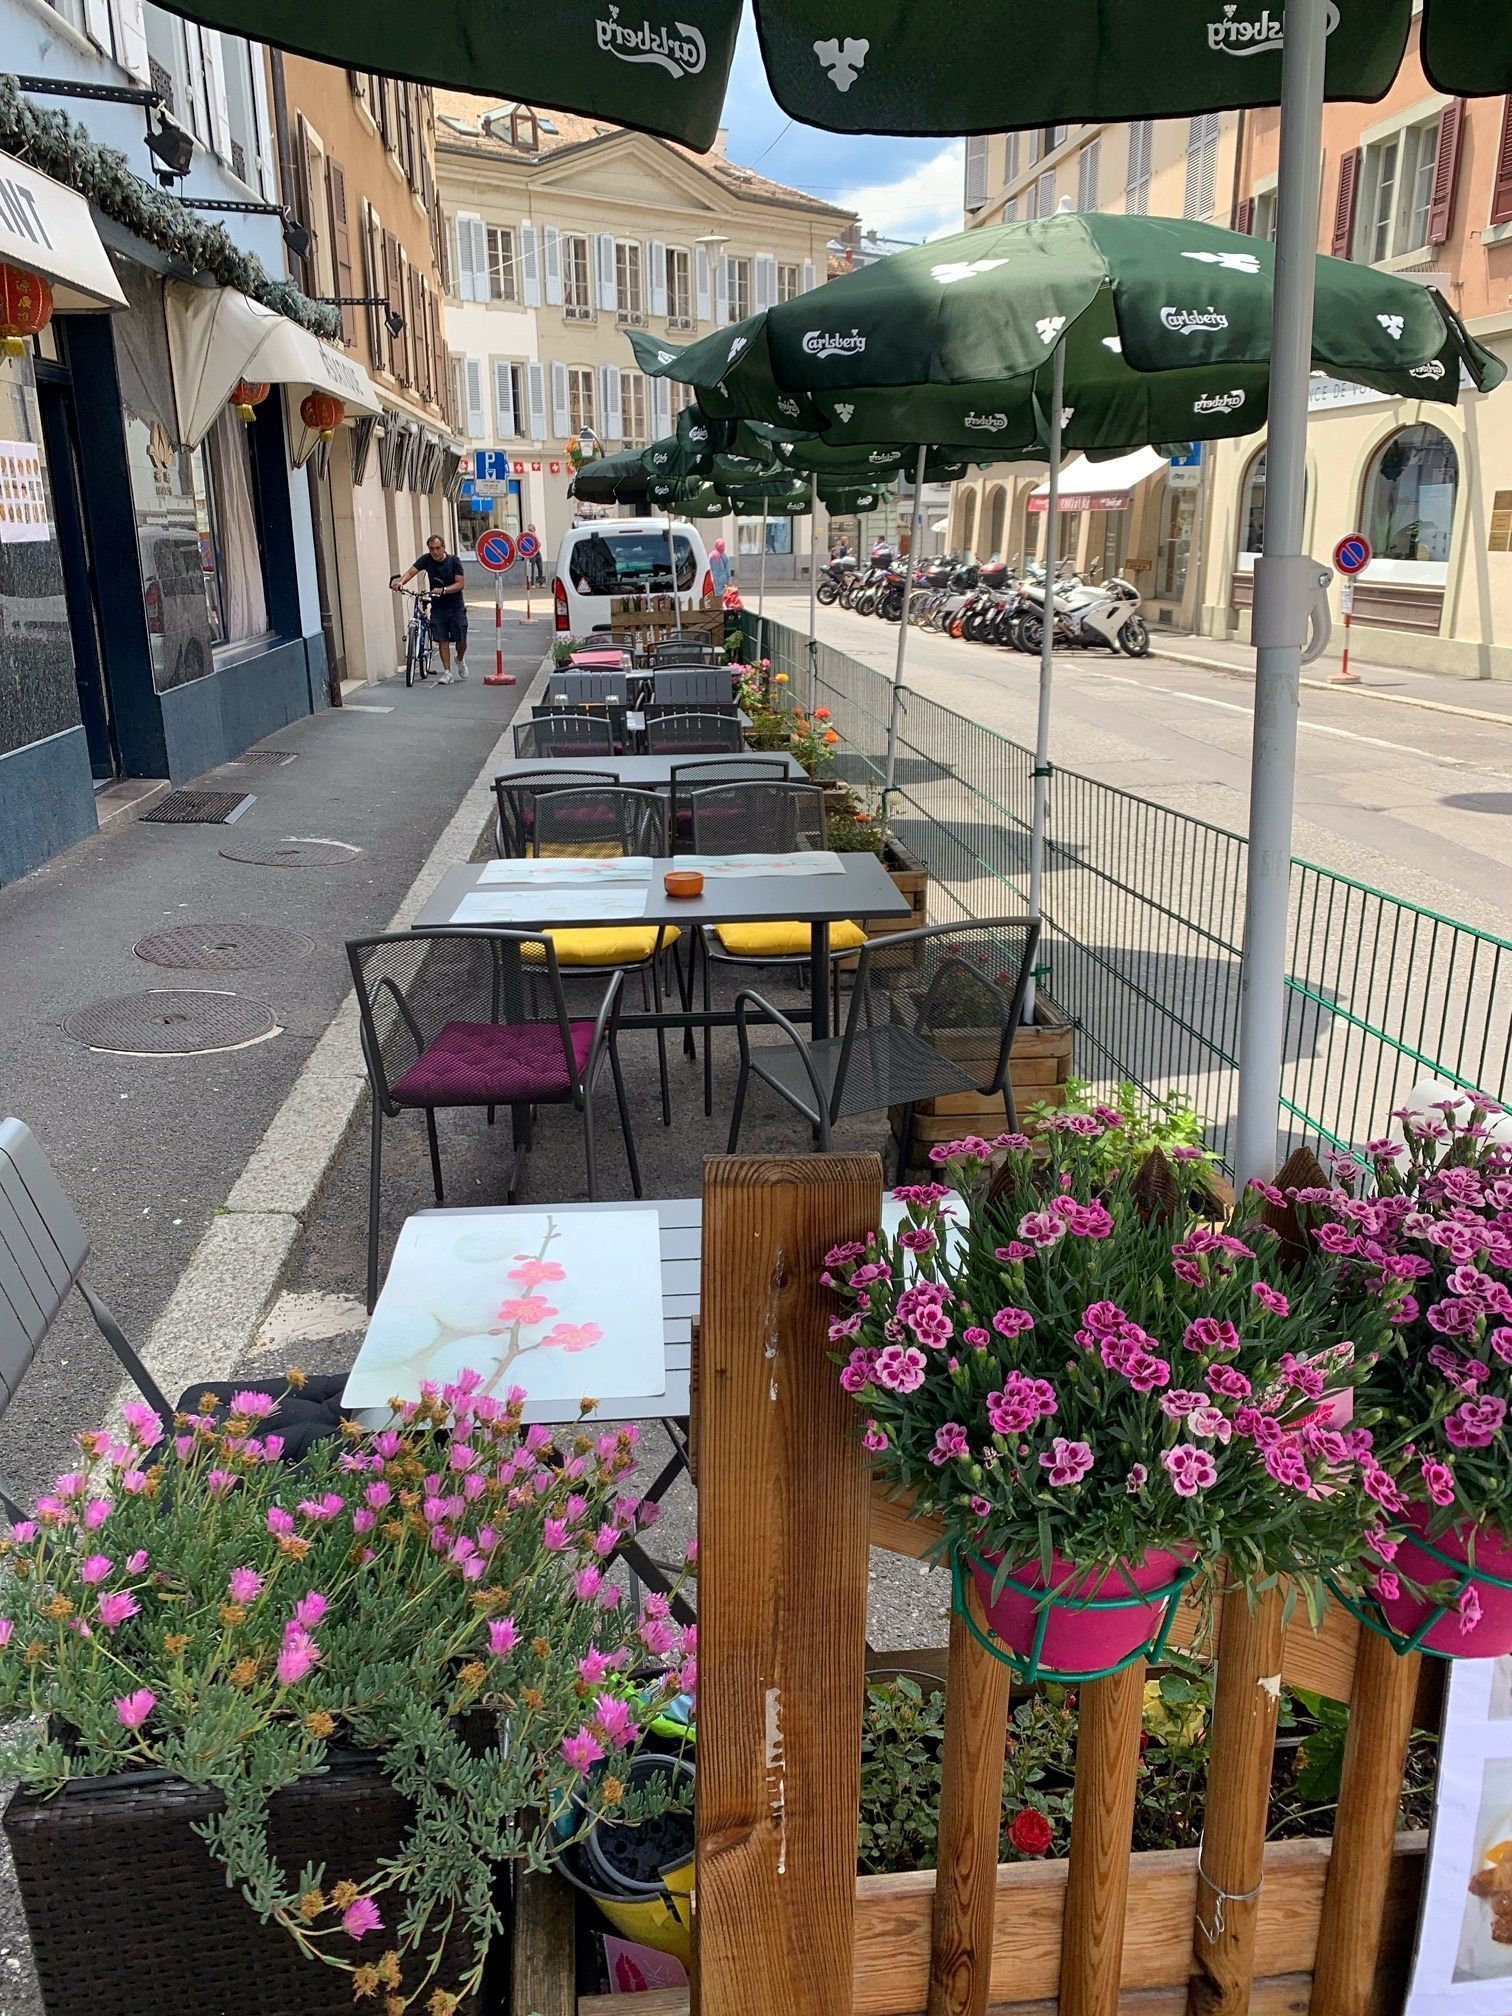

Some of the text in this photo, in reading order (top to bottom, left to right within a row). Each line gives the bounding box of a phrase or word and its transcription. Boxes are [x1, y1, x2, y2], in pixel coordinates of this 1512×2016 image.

[1160, 306, 1229, 335] Carlsberg
[802, 329, 867, 359] Carlsberg
[1334, 383, 1346, 398] DE
[485, 451, 495, 469] P
